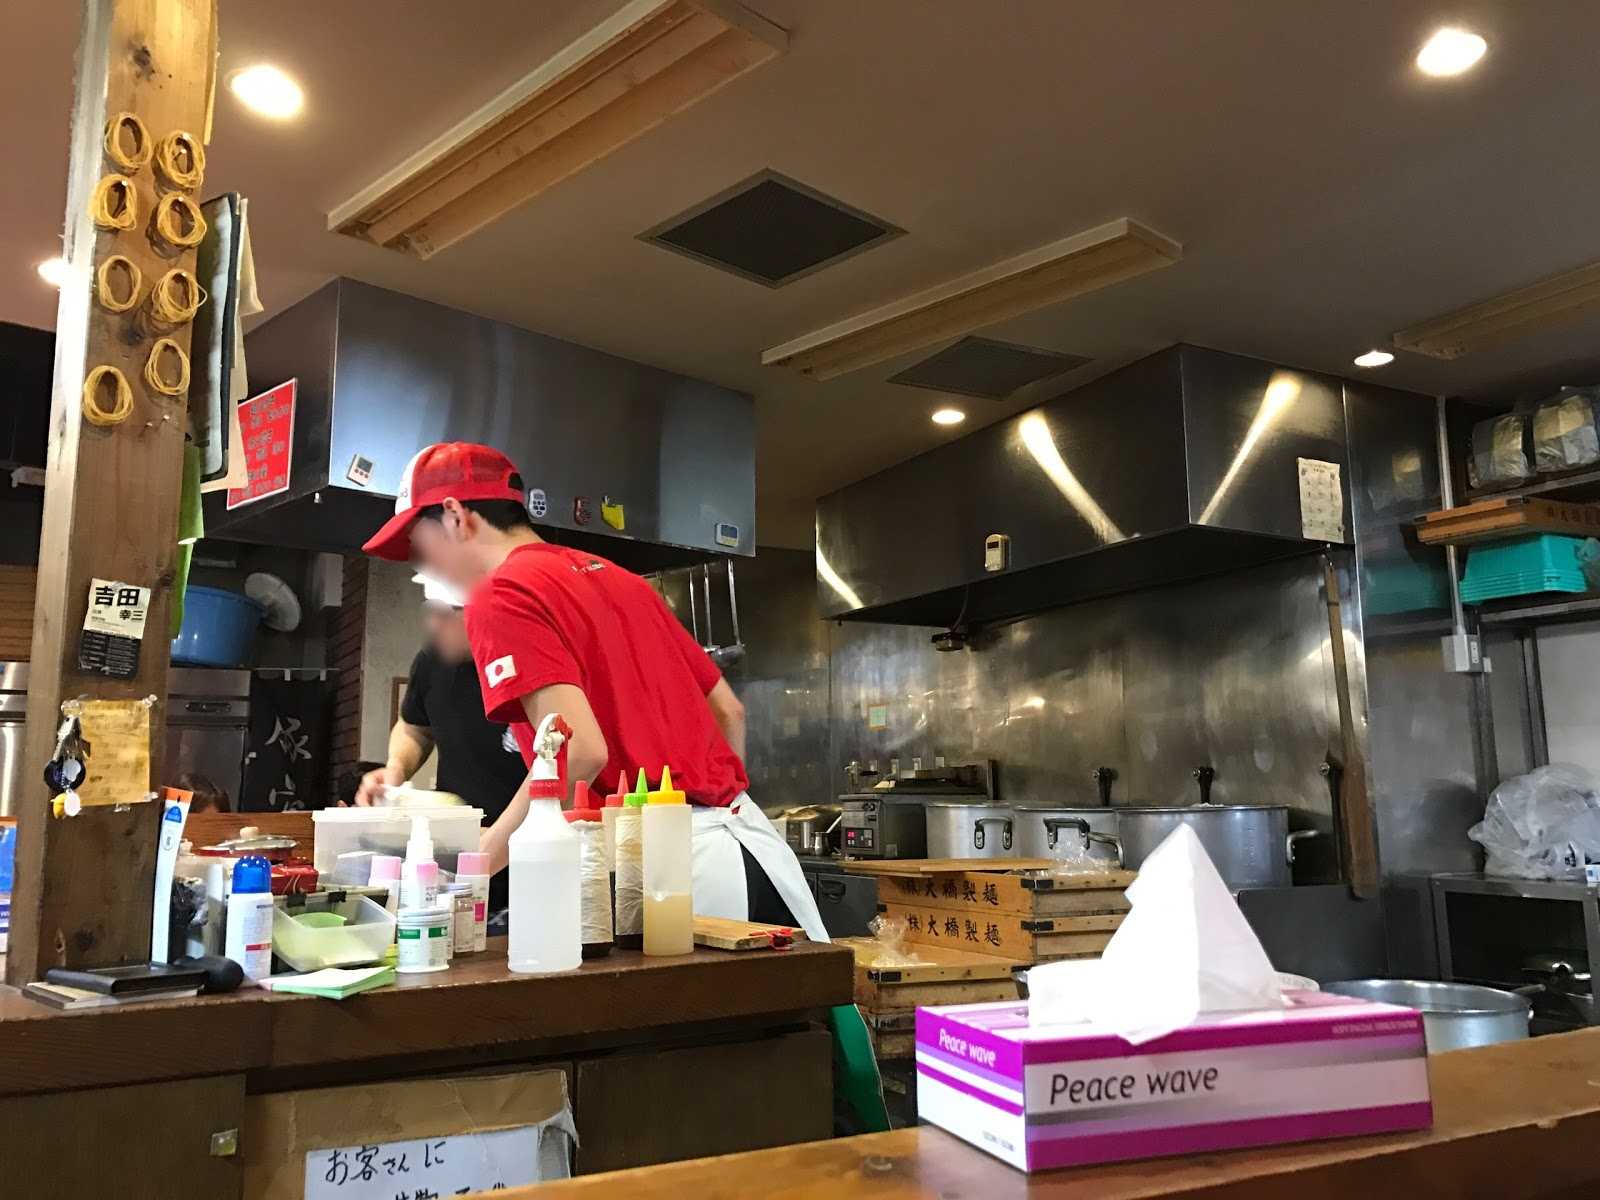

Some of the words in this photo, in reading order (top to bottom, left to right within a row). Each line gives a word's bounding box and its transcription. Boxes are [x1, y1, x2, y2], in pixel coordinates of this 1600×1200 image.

[95, 585, 141, 607] 吉田
[938, 1028, 967, 1055] Peace
[968, 1041, 997, 1067] wave
[1049, 1073, 1136, 1106] Peace
[1146, 1066, 1219, 1095] wave
[325, 1141, 447, 1186] お客さんに
